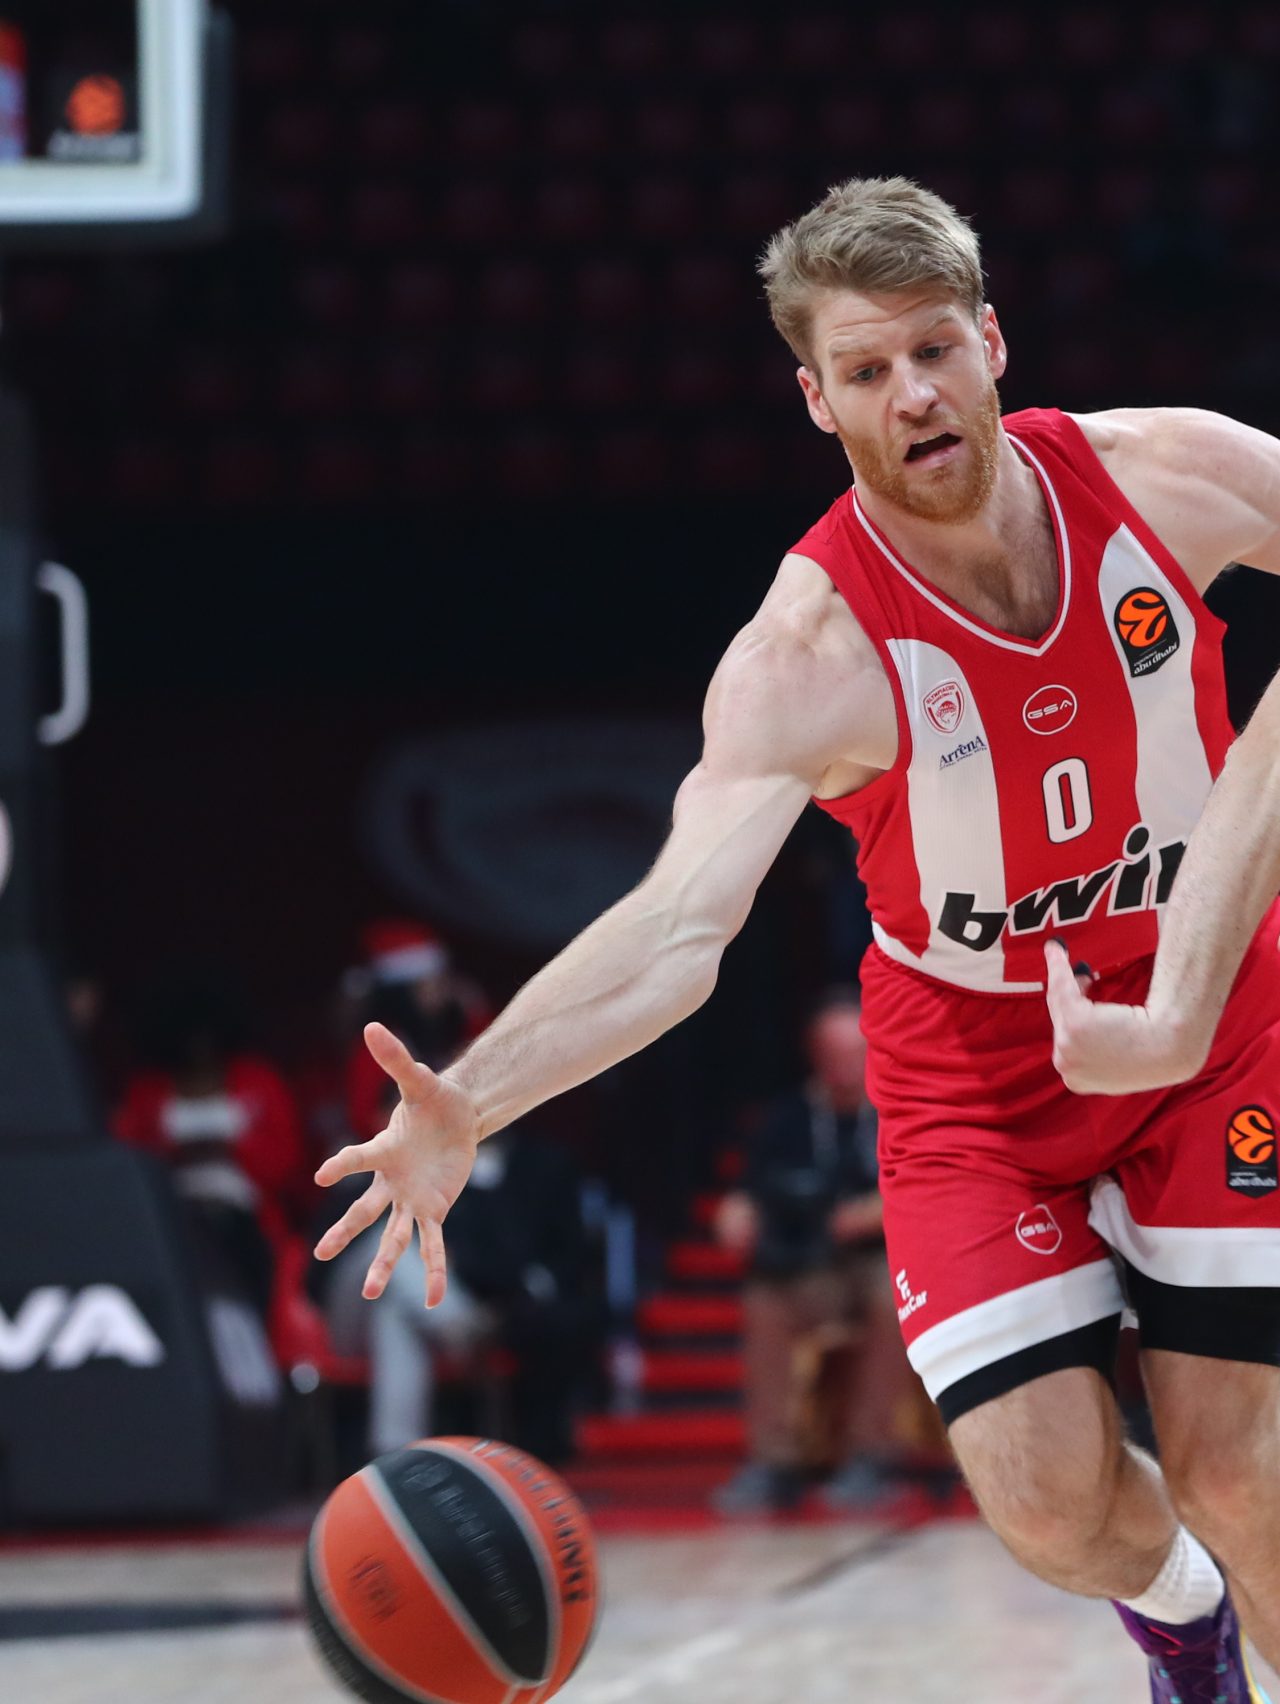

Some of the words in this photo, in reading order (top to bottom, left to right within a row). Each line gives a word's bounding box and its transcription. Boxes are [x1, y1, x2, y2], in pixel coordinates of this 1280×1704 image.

[1133, 660, 1152, 675] abu
[1152, 641, 1178, 664] dhabi
[1027, 699, 1073, 719] GSA
[1041, 756, 1095, 845] 0
